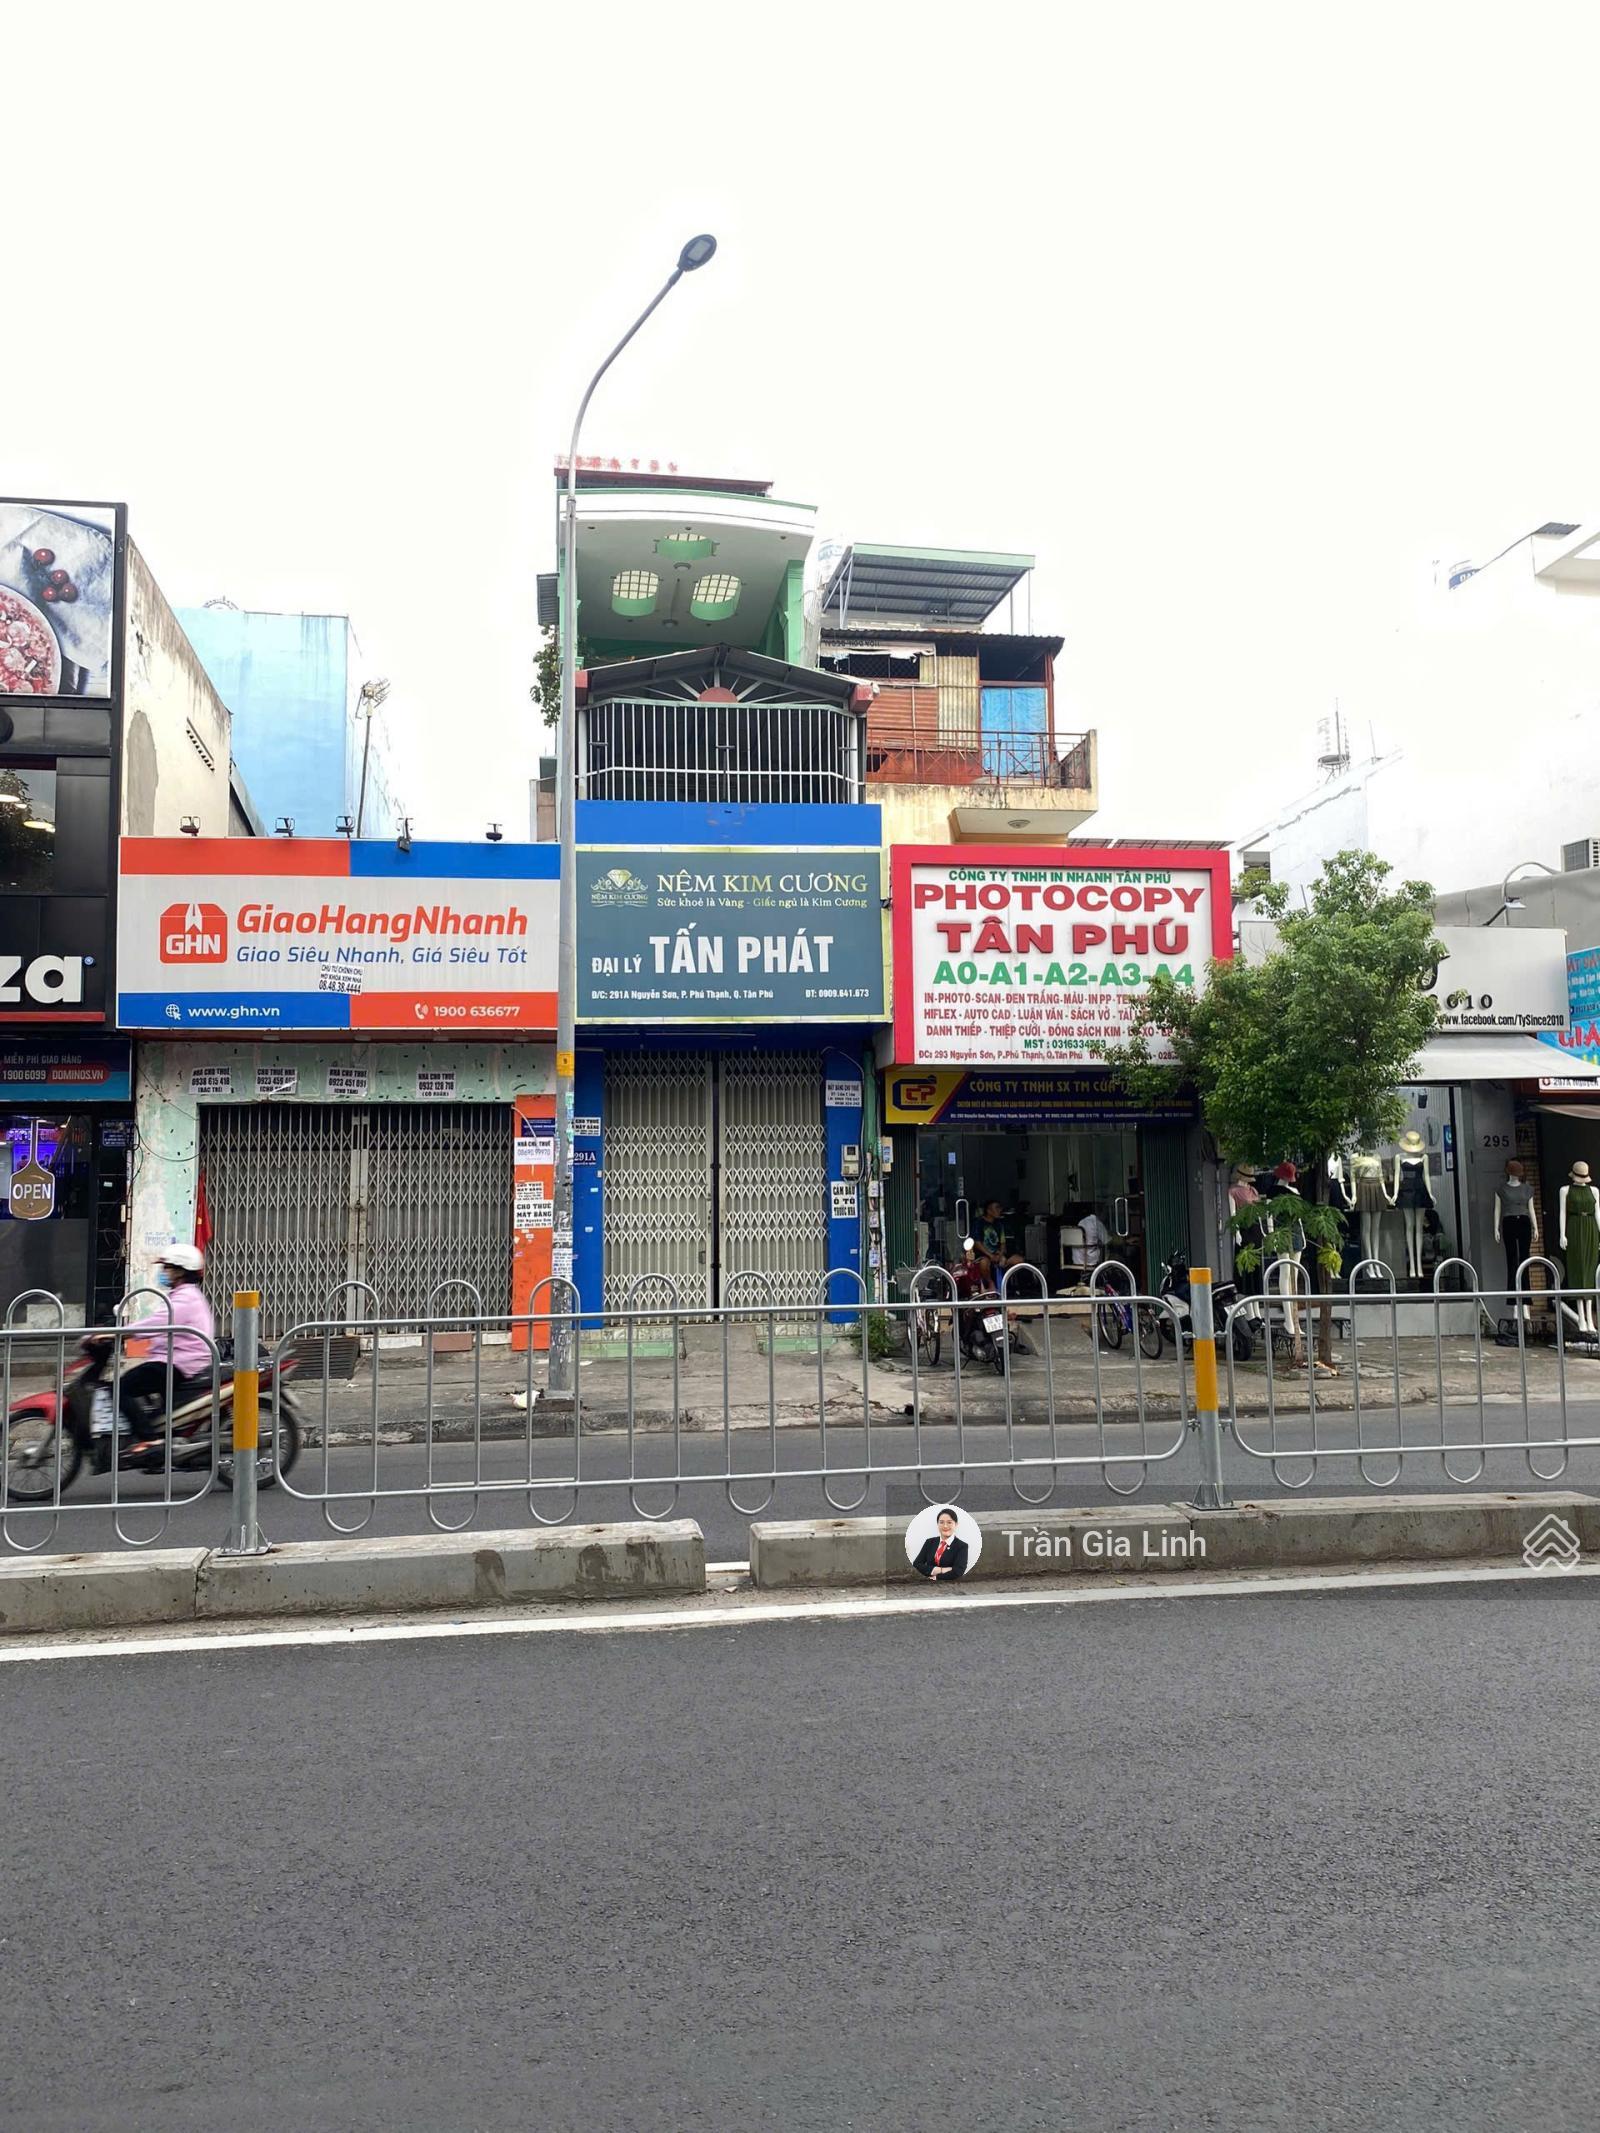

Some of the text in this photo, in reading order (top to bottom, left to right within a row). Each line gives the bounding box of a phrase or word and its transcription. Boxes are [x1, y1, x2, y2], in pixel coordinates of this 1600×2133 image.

[657, 869, 869, 897] NỆM KIM CƯƠNG
[949, 868, 1171, 884] CÔNG TY TNHH IN NHANH TÂN PHÚ
[657, 897, 677, 908] Sức
[706, 898, 715, 908] là
[719, 897, 744, 910] Vàng
[753, 896, 776, 908] Giấc
[800, 898, 809, 908] là
[812, 898, 832, 908] Kim
[834, 897, 868, 910] Cương
[914, 884, 1205, 913] PHOTOCOPY
[237, 903, 528, 943] GiaoHangNhanh
[937, 916, 1189, 955] TÂN PHÚ
[166, 934, 221, 955] GHN
[649, 922, 833, 973] TẤN PHÁT
[237, 945, 528, 965] Giao Siêu Nhanh, Giá Siêu Tốt
[592, 954, 643, 976] ĐẠI LÝ
[319, 979, 362, 994] 08.48.38.4444
[610, 990, 629, 999] 291A
[681, 990, 688, 999] P.
[690, 990, 704, 999] Phú
[734, 990, 741, 999] Q.
[743, 990, 757, 998] Tân
[759, 989, 774, 998] Phú
[188, 1005, 280, 1019] www.ghn.vn
[433, 1006, 521, 1018] 1900 636677
[924, 1009, 957, 1020] HIFLEX
[964, 1009, 989, 1020] AUTO
[991, 1009, 1011, 1020] CAD
[1018, 1008, 1043, 1023] LUẬN
[1070, 1007, 1095, 1021] SÁCH
[926, 1025, 952, 1036] DANH
[955, 1021, 982, 1036] THIẾP
[990, 1024, 1016, 1039] THIỆP
[1048, 1023, 1074, 1037] ĐÓNG
[1077, 1023, 1102, 1037] SÁCH
[1104, 1026, 1121, 1037] KIM
[1024, 1039, 1044, 1049] MST
[934, 1050, 948, 1059] 293
[950, 1047, 978, 1061] Nguyễn
[1069, 1050, 1083, 1059] Phú
[52, 1070, 104, 1080] DOMINOS.VN
[970, 1079, 1001, 1092] CÔNG
[1004, 1081, 1019, 1093] TY
[1021, 1081, 1053, 1093] TNHH
[1056, 1081, 1070, 1093] SX
[1072, 1081, 1090, 1093] TM
[1483, 1135, 1510, 1148] 295
[574, 1152, 597, 1161] 291A
[13, 1183, 51, 1200] OPEN
